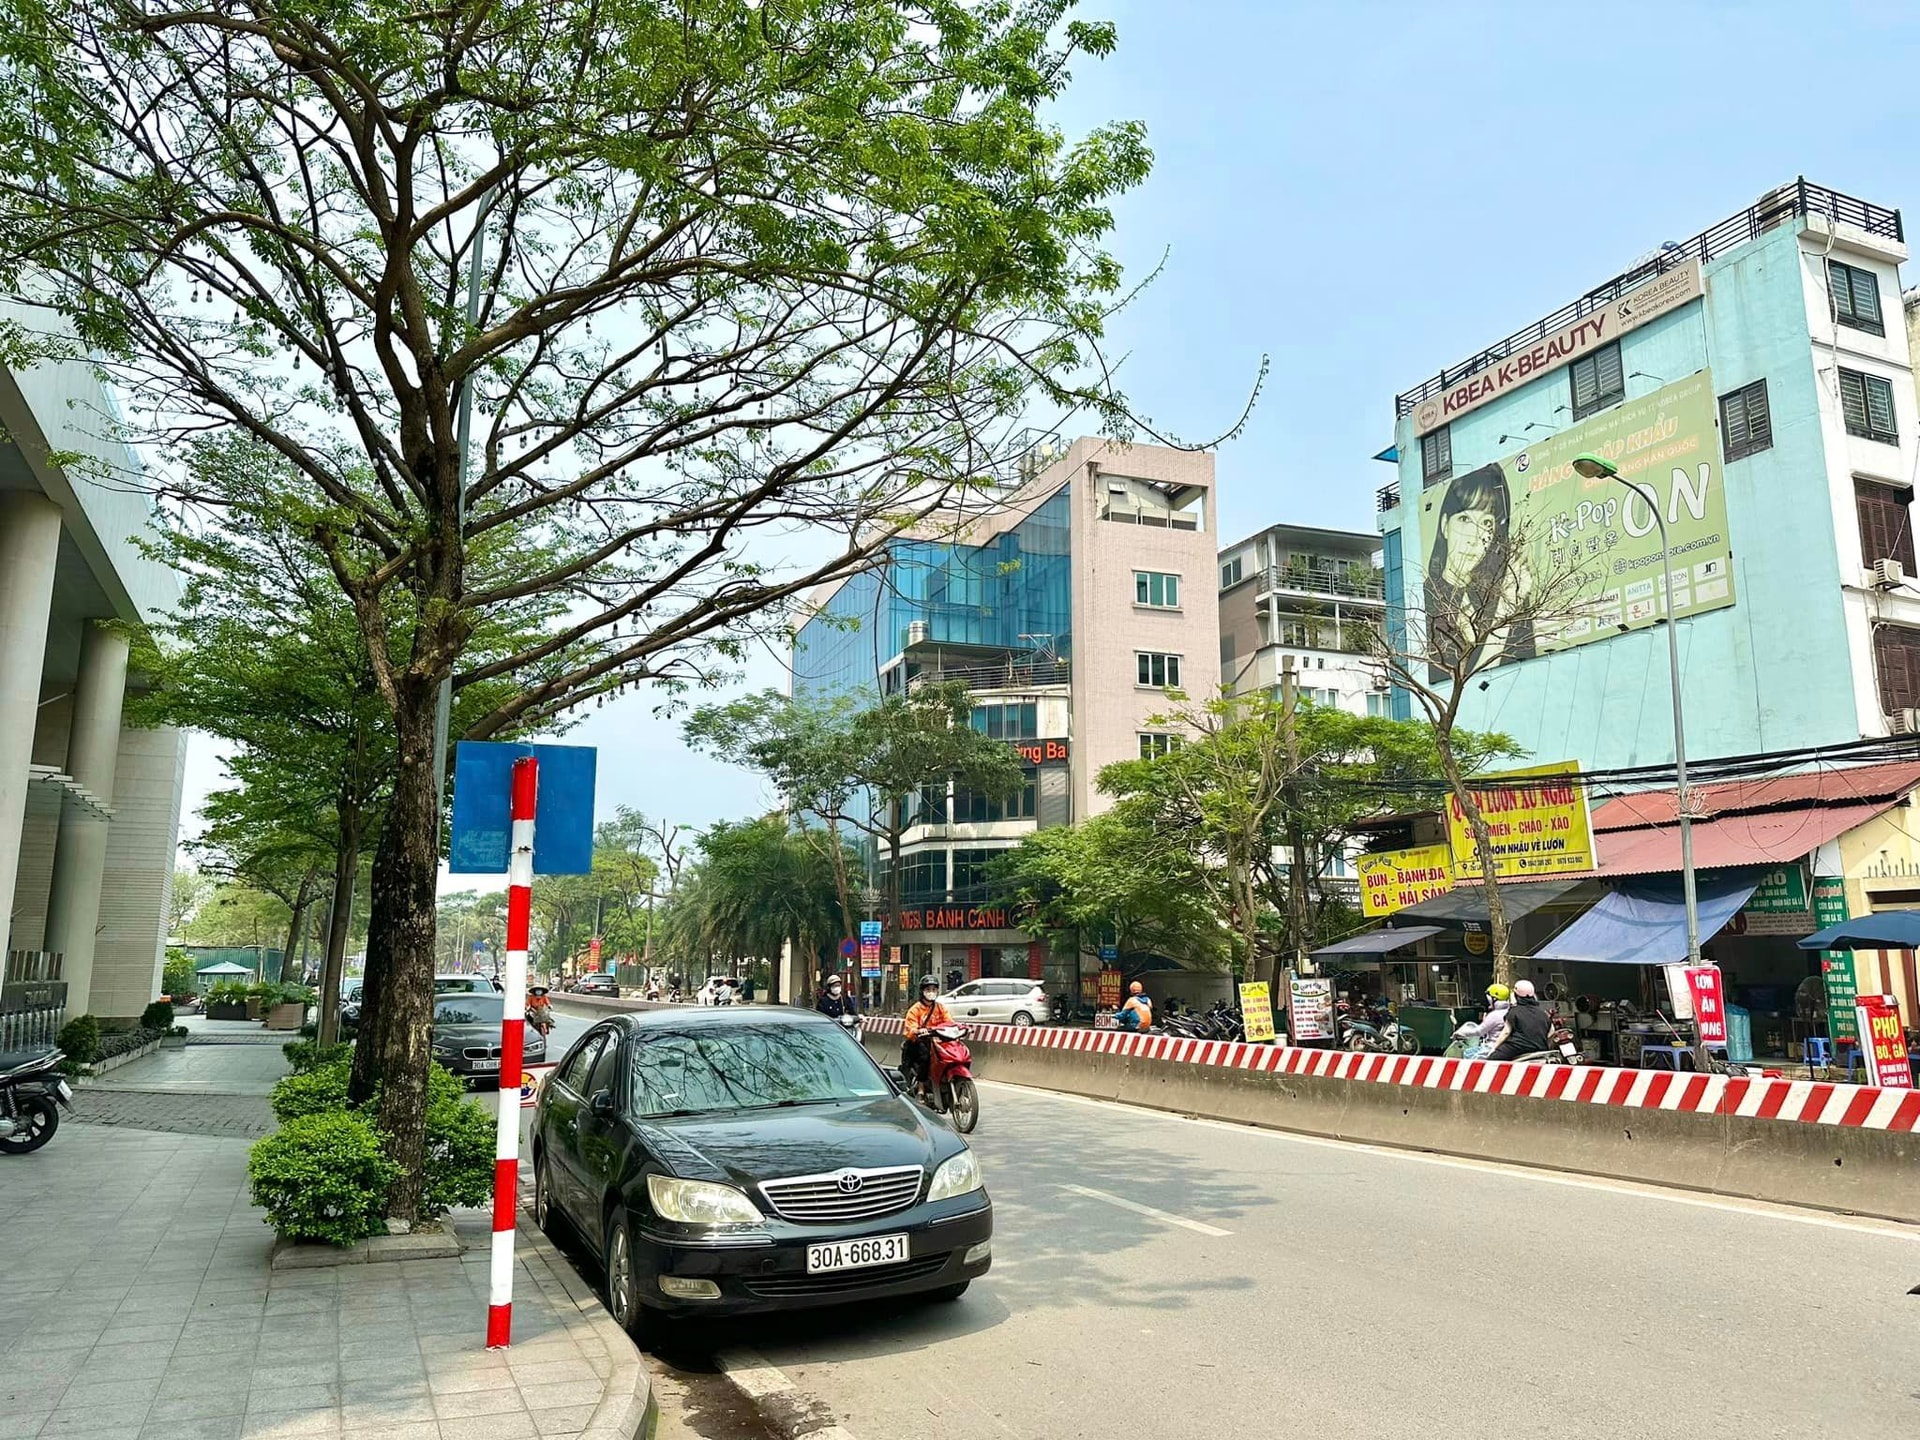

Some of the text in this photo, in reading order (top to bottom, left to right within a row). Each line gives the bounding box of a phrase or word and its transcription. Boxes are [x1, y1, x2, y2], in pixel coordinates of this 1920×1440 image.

[1633, 285, 1659, 304] KOREA
[1659, 269, 1690, 291] BEAUTY
[1443, 313, 1606, 416] KBEA K-BEAUTY
[1549, 462, 1711, 544] K-Pop ON
[1046, 741, 1066, 759] Ba
[1518, 818, 1543, 834] CHÁO
[1551, 814, 1570, 831] XÀO
[1507, 839, 1530, 855] NHẬU
[1366, 872, 1388, 889] BÚN
[1397, 868, 1428, 884] BÁNH
[1428, 867, 1446, 881] ĐA
[926, 905, 964, 929] BÁNH
[1872, 1010, 1899, 1040] PHỞ
[1892, 1040, 1906, 1058] GÀ
[811, 1237, 904, 1269] 30A-668.31
